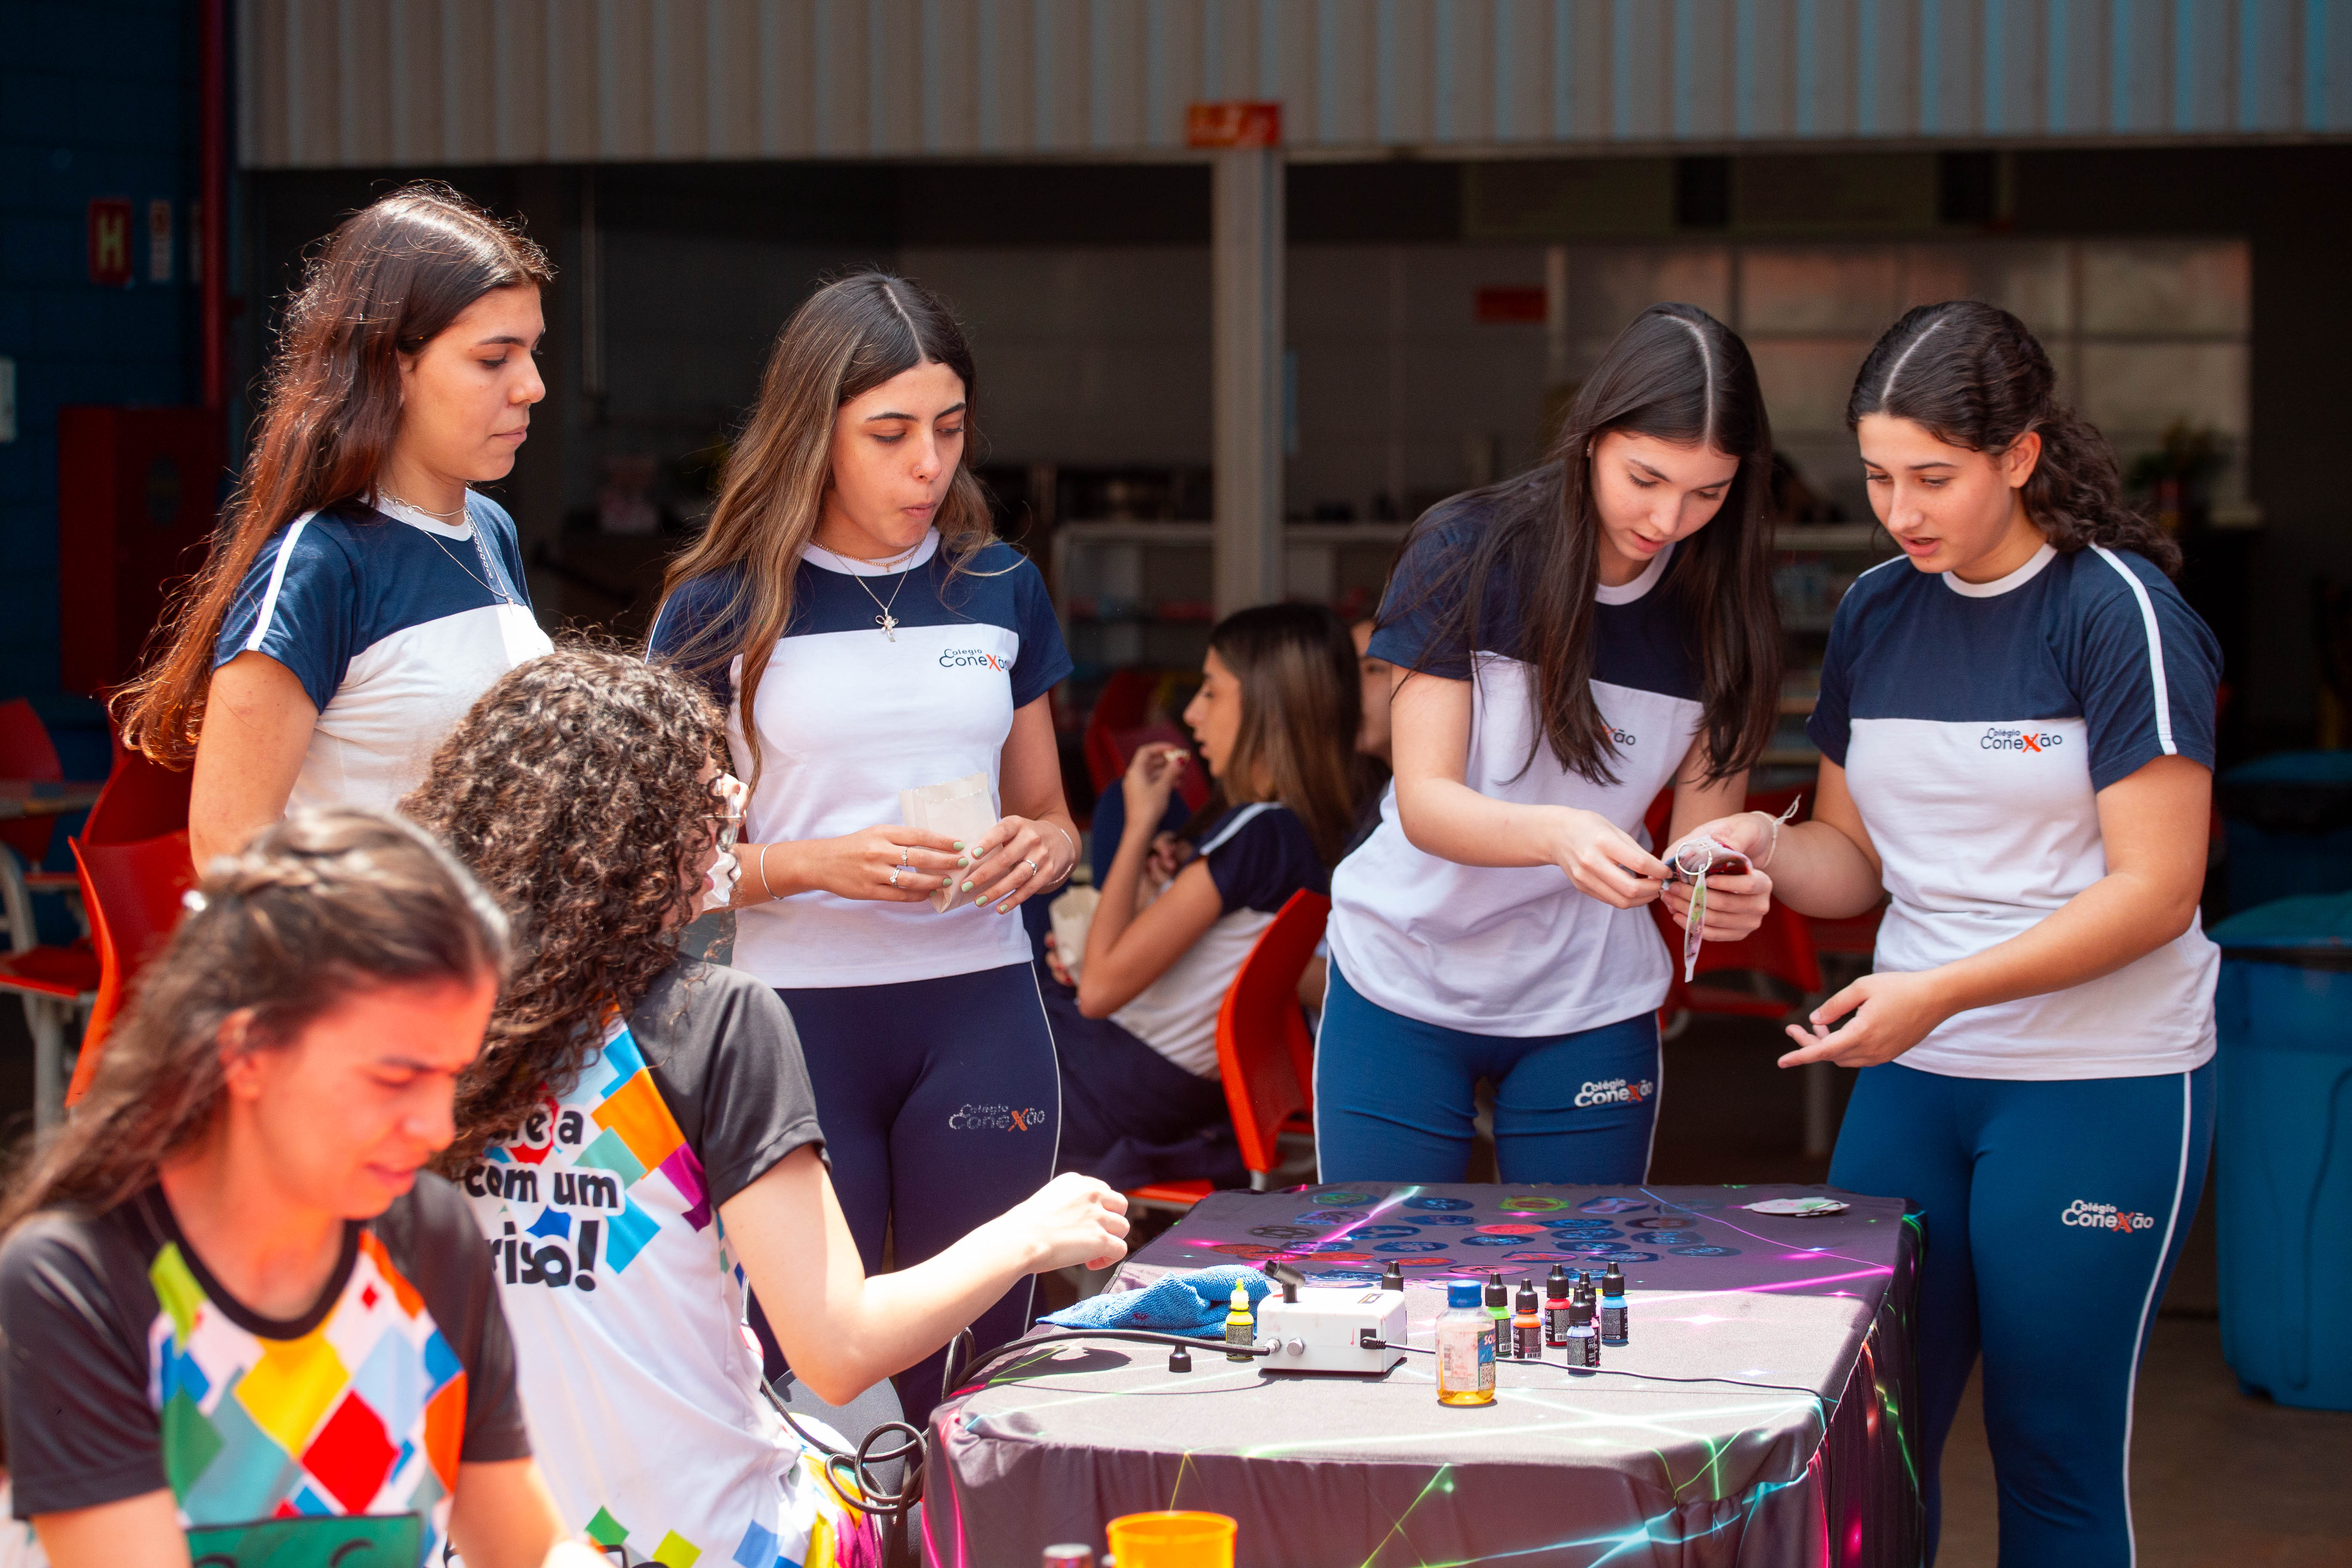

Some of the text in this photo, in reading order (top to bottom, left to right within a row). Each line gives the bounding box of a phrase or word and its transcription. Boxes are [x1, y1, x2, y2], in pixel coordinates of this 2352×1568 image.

[97, 212, 125, 272] H
[1981, 733, 2063, 753] ConeXão
[1574, 1079, 1654, 1107] ConeXão
[949, 1108, 1045, 1131] ConeXão
[465, 1165, 618, 1208] com um
[2061, 1208, 2155, 1234] ConeXão
